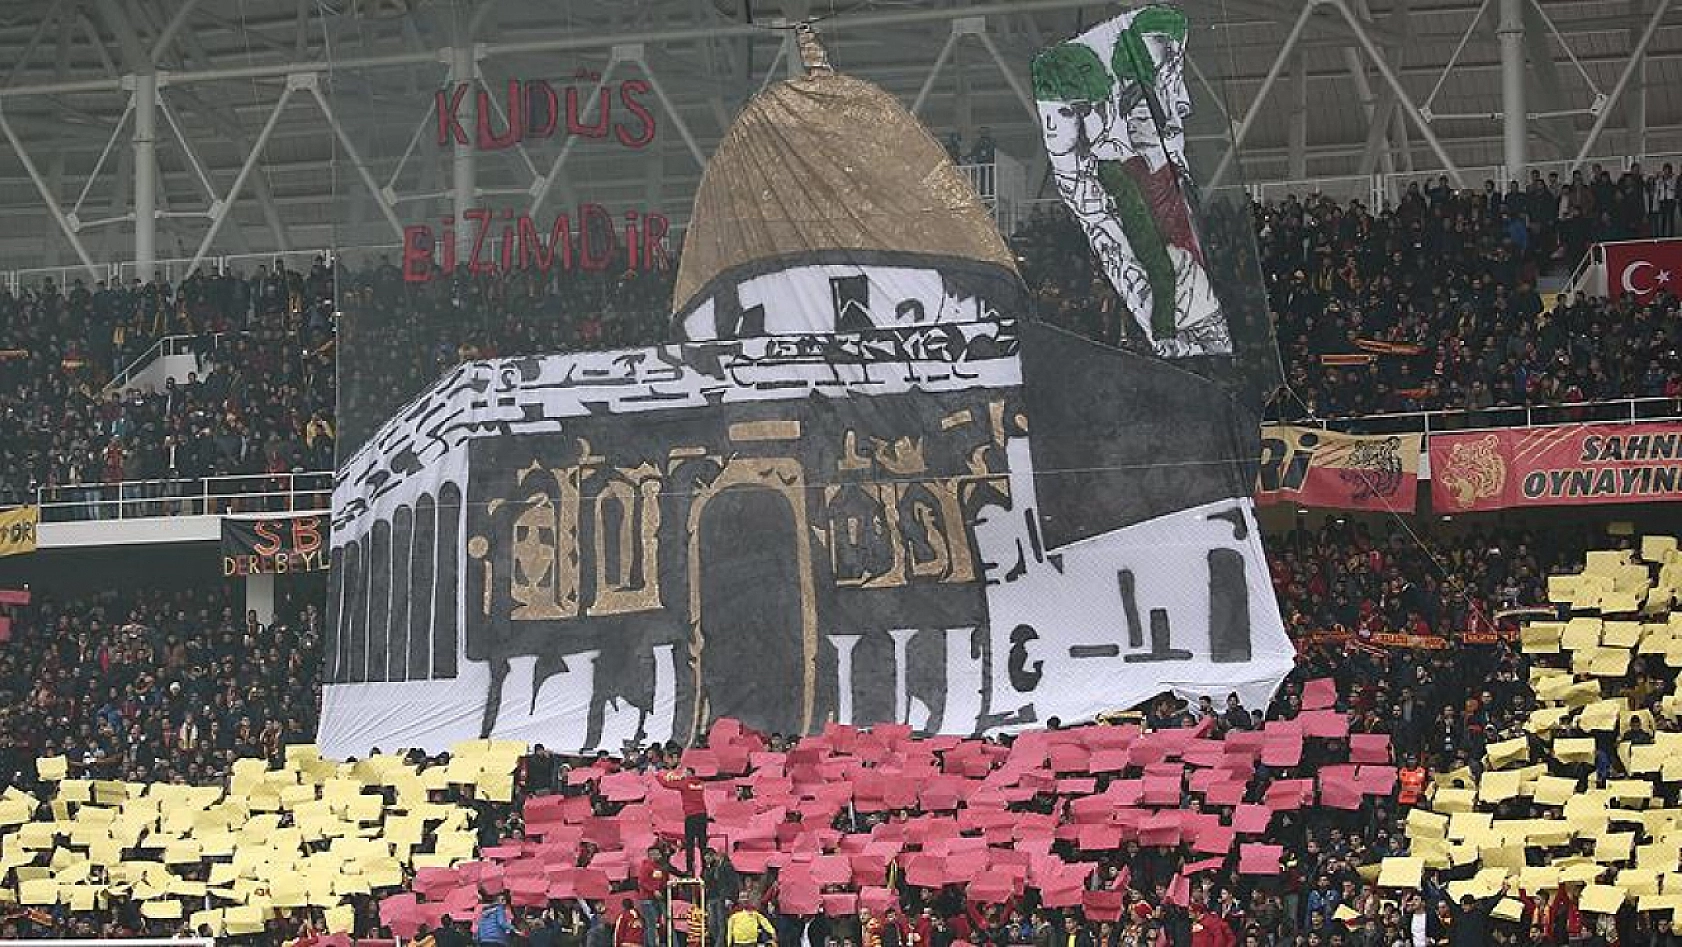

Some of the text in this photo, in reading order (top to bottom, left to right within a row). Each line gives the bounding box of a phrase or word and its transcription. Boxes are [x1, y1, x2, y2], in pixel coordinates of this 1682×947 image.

[435, 68, 655, 149] KUDÜS
[1579, 432, 1682, 464] SAHN
[1522, 464, 1682, 498] OYNAYIN
